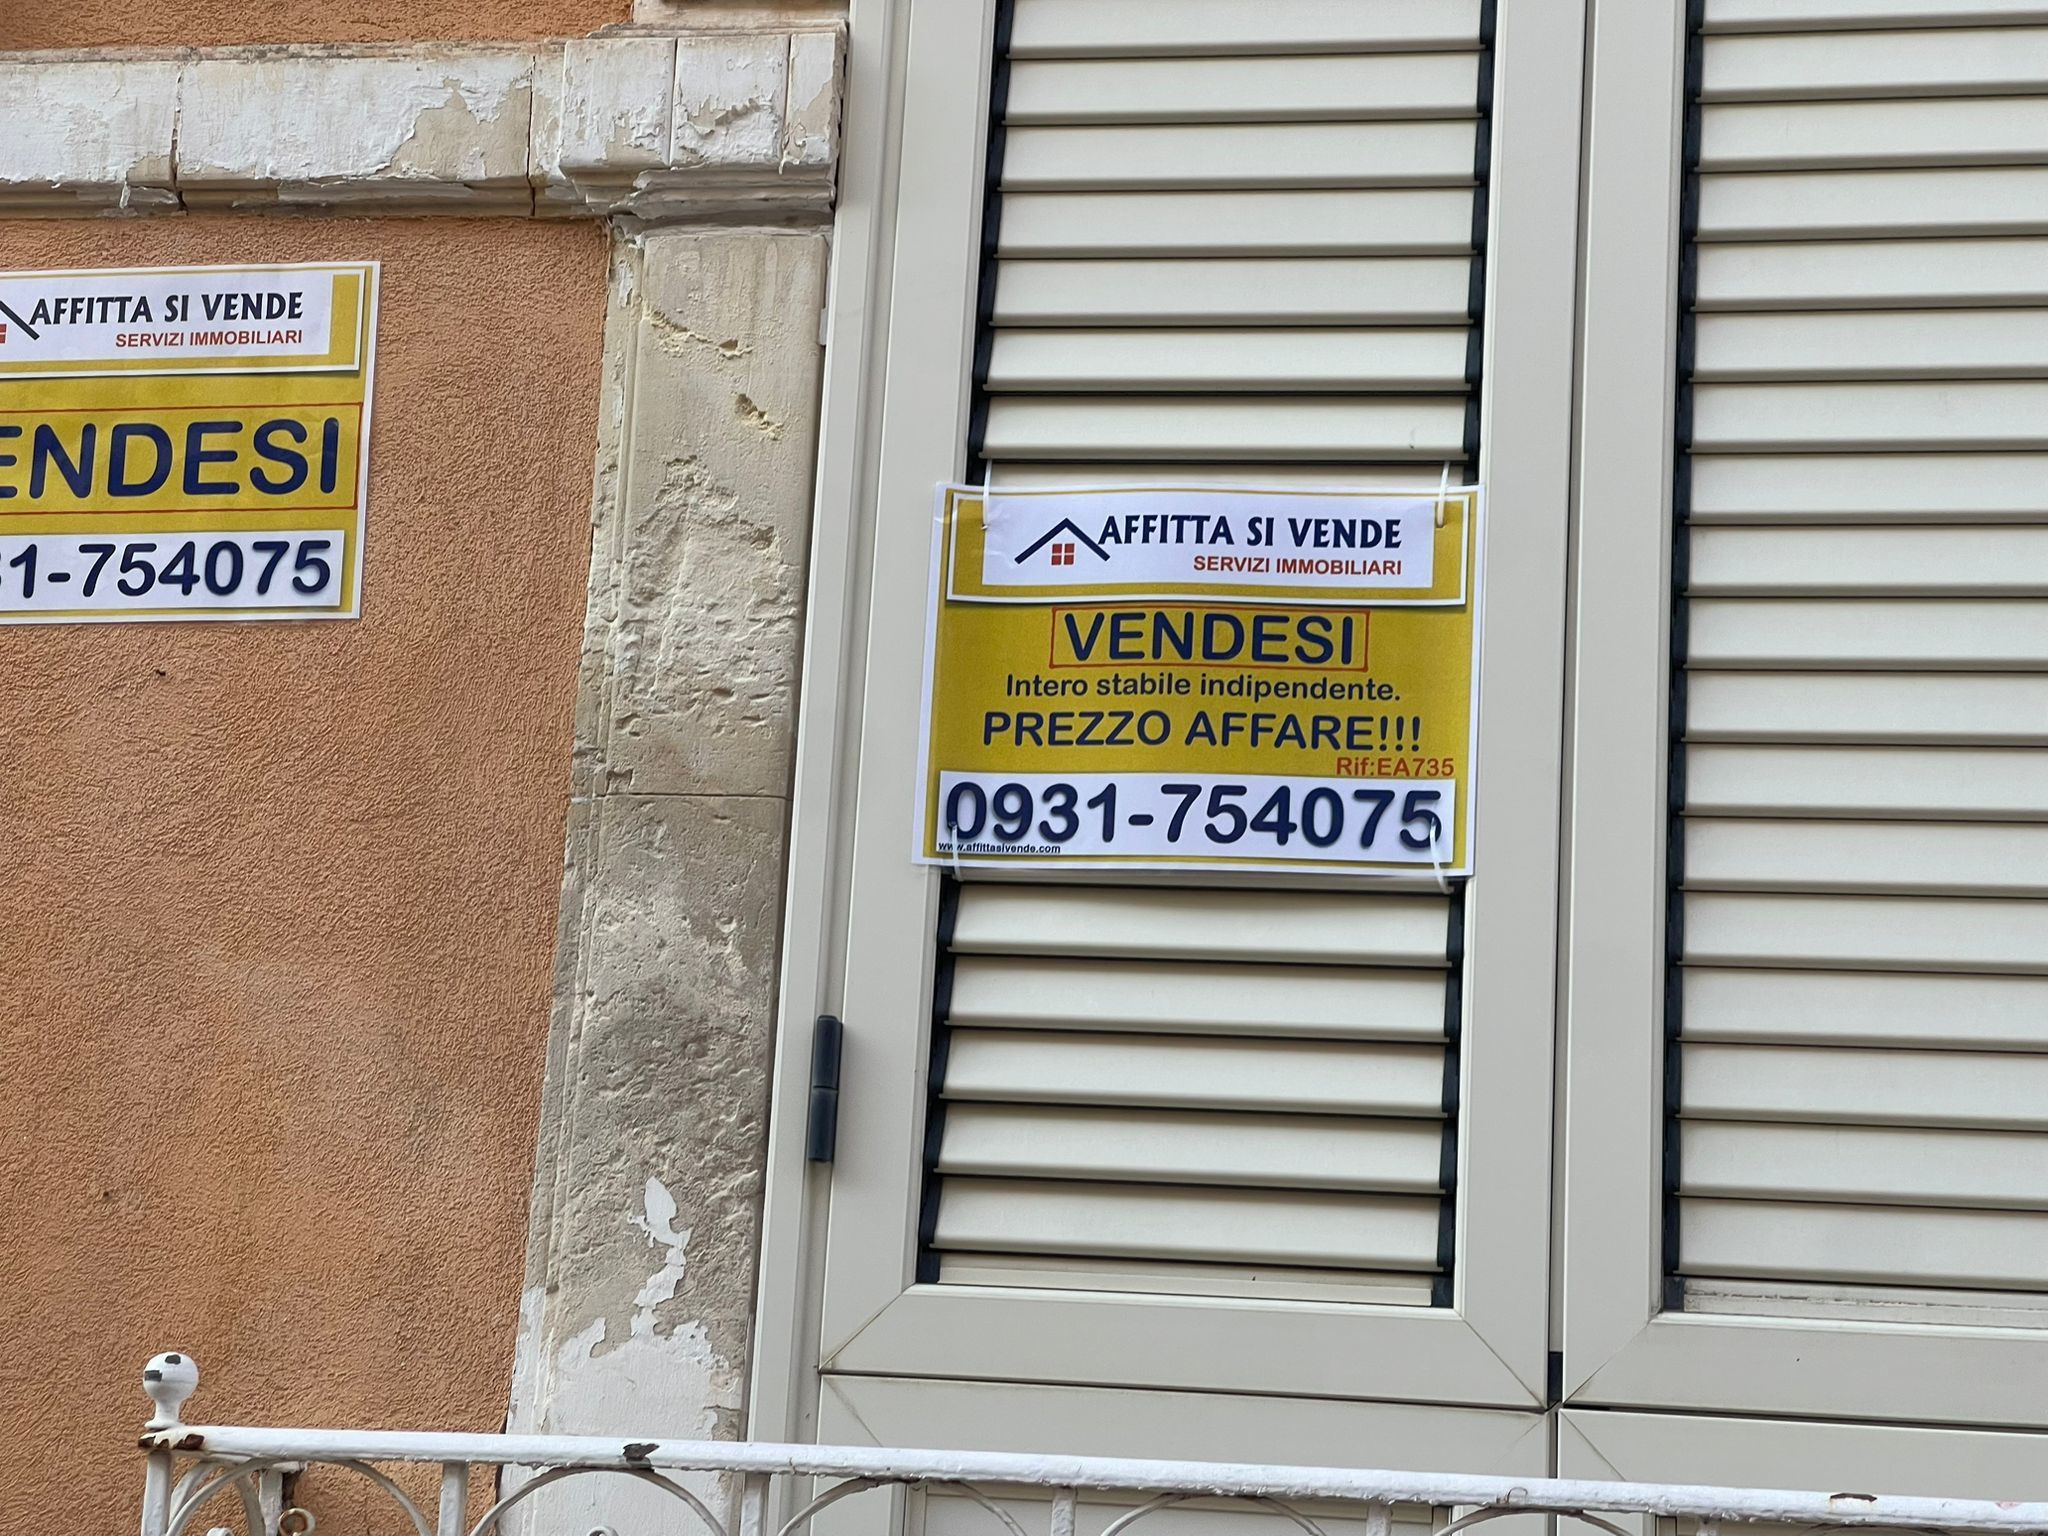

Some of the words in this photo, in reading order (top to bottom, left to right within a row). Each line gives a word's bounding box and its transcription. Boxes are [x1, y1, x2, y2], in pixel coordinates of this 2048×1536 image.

[29, 295, 153, 325] AFFITTA
[164, 294, 188, 322] SI
[200, 291, 303, 321] VENDE
[115, 332, 184, 348] SERVIZI
[190, 329, 302, 346] IMMOBILIARI
[1098, 514, 1235, 545] AFFITTA
[1247, 516, 1274, 547] SI
[1288, 518, 1402, 549] VENDE
[0, 540, 331, 599] 1-754075
[1193, 556, 1270, 573] SERVIZI
[1276, 558, 1402, 575] IMMOBILIARI
[1064, 612, 1354, 665] VENDESI
[1006, 673, 1089, 698] Intero
[1096, 672, 1191, 696] stabile
[1200, 673, 1401, 703] indipendente.
[983, 710, 1171, 747] PREZZO
[1184, 711, 1421, 752] AFFARE!!!
[1336, 756, 1455, 777] Rif:EA735
[946, 781, 1442, 850] 0931-754075
